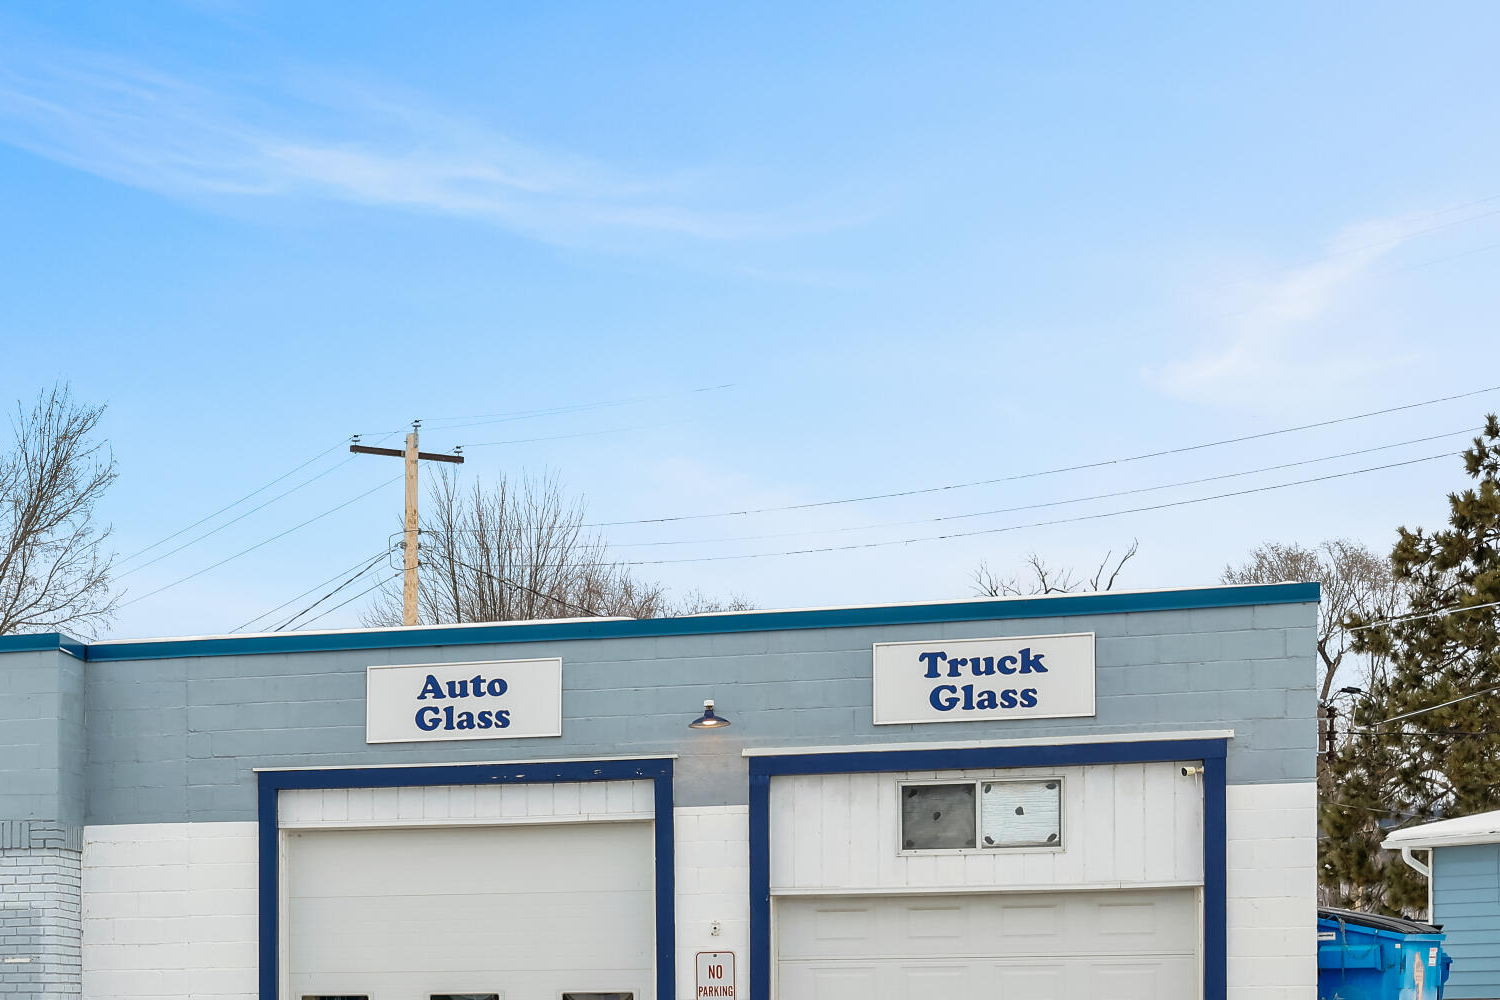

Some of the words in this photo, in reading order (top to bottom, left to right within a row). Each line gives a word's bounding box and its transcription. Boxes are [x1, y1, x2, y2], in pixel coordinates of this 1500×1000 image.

[918, 647, 1049, 679] Truck
[416, 674, 509, 700] Auto
[929, 684, 1038, 712] Glass
[414, 705, 511, 732] Glass
[708, 964, 723, 979] NO
[698, 985, 734, 997] PARKING
